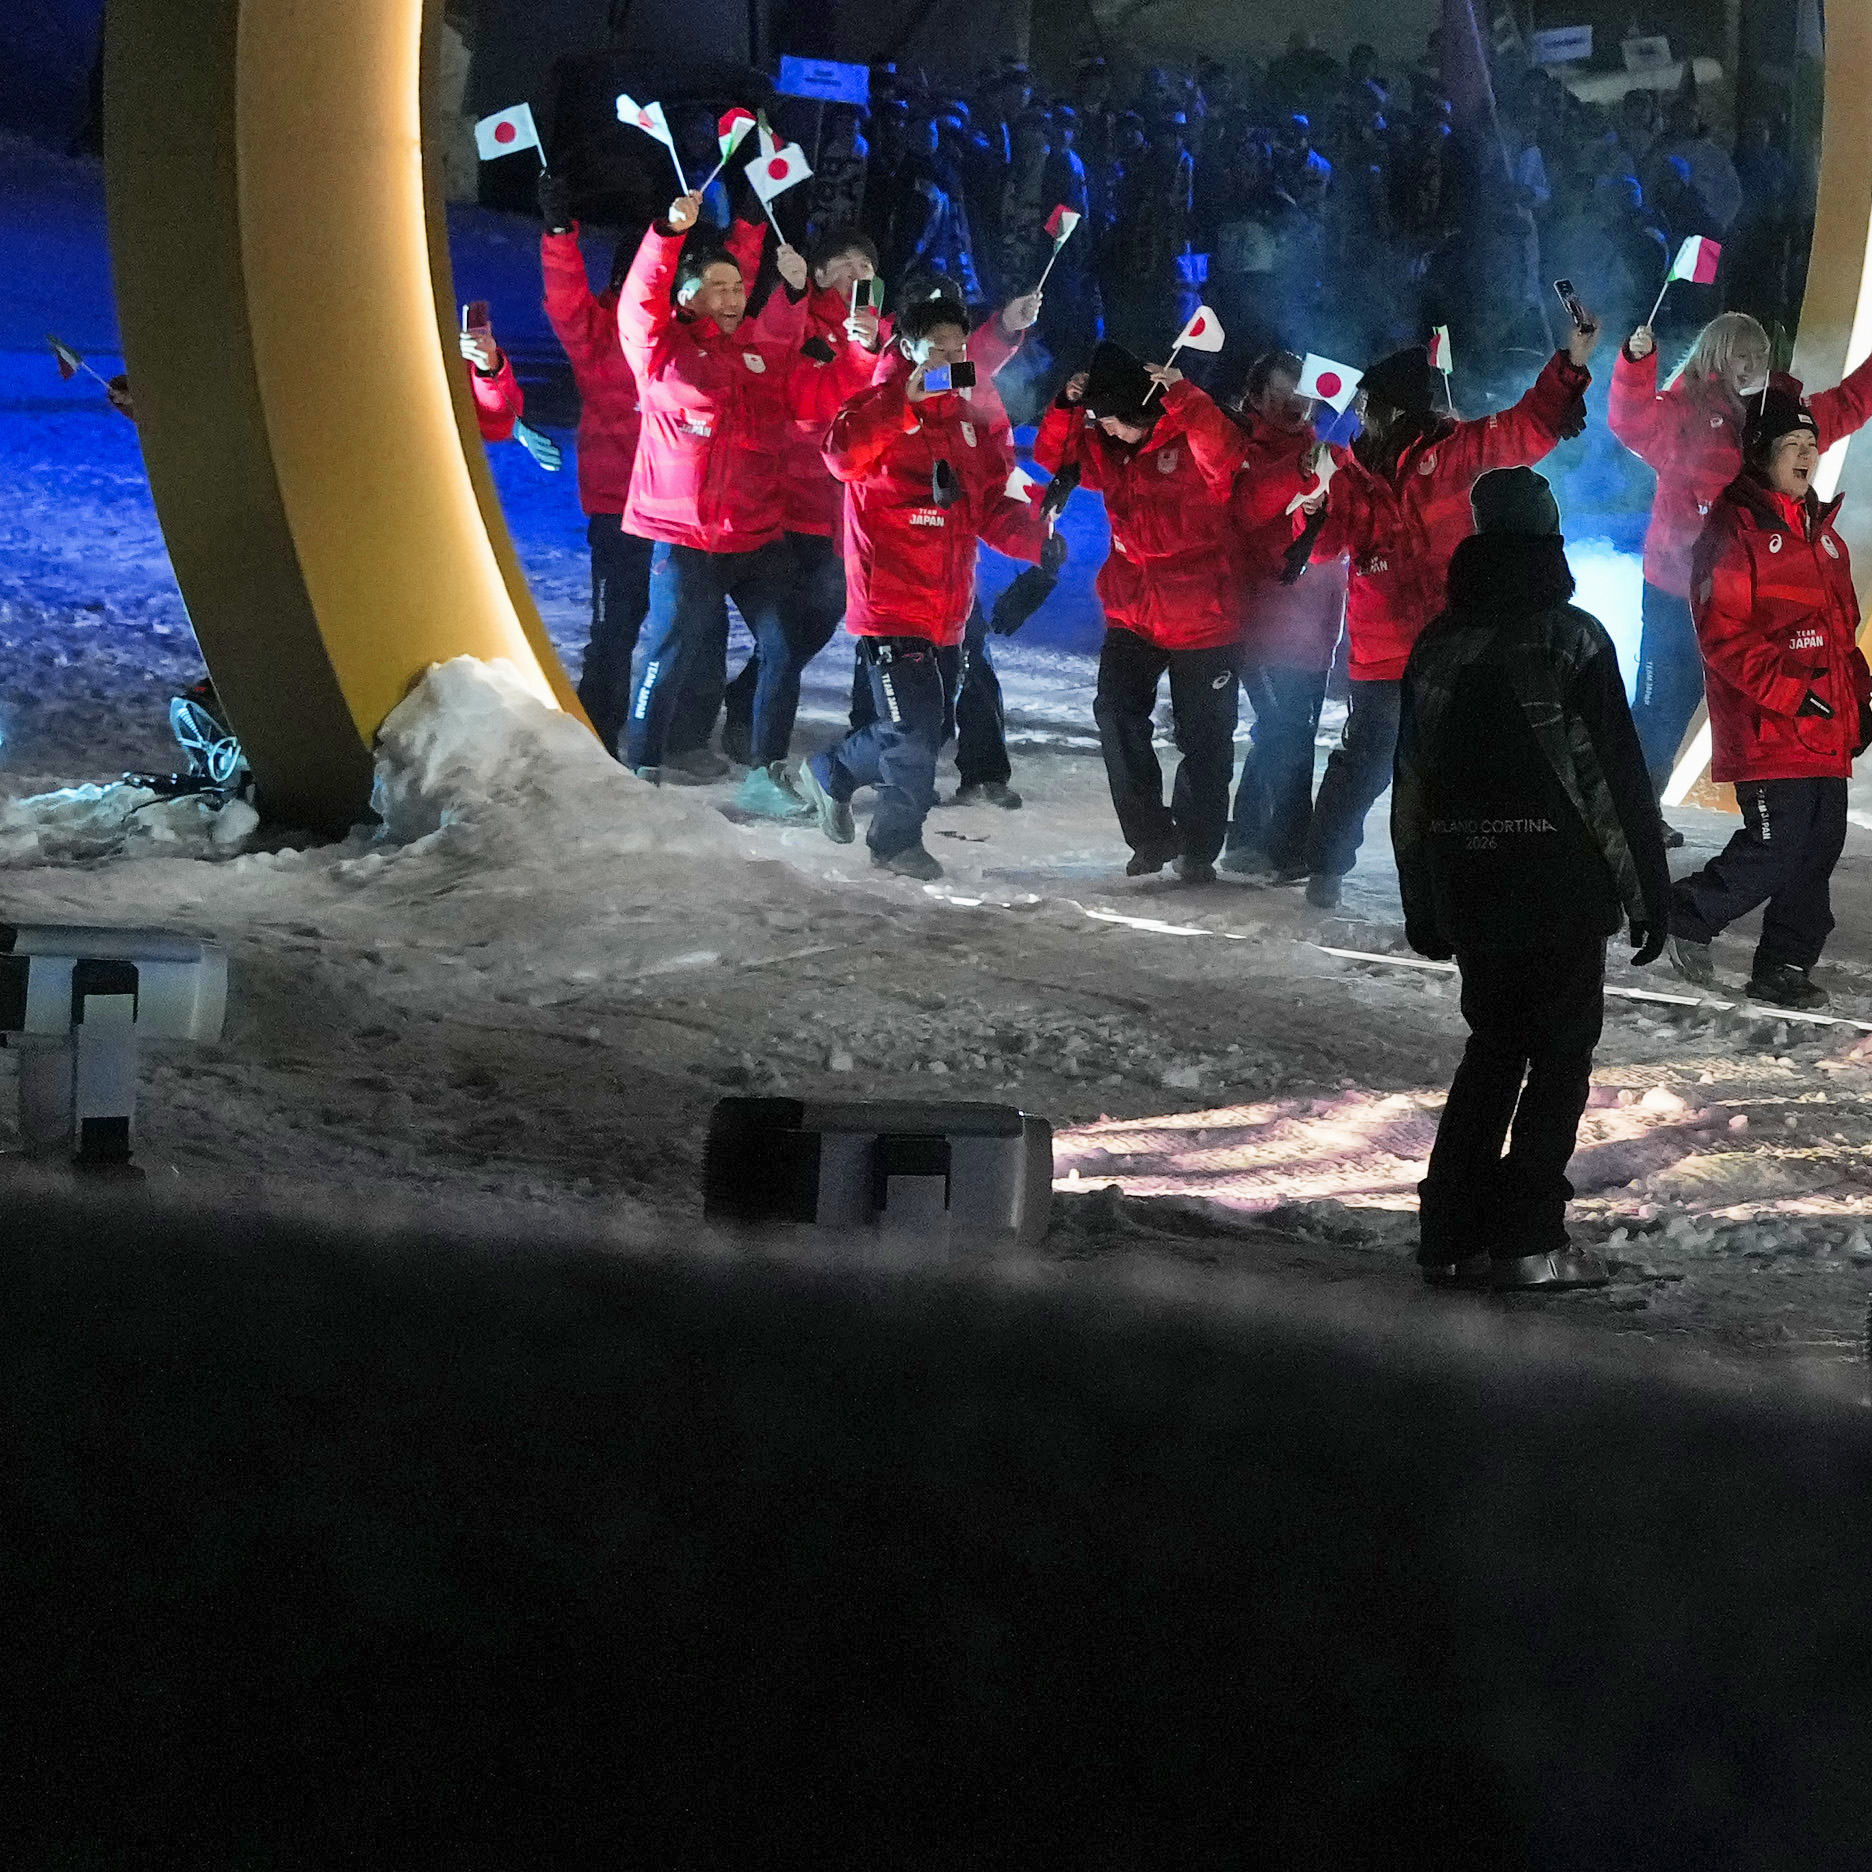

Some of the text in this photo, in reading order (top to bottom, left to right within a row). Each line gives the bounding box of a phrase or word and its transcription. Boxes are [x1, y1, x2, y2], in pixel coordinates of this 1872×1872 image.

[910, 514, 945, 527] JAPAN
[1789, 636, 1823, 649] JAPAN
[1480, 819, 1558, 833] CORTINA
[1466, 835, 1498, 850] 2026
